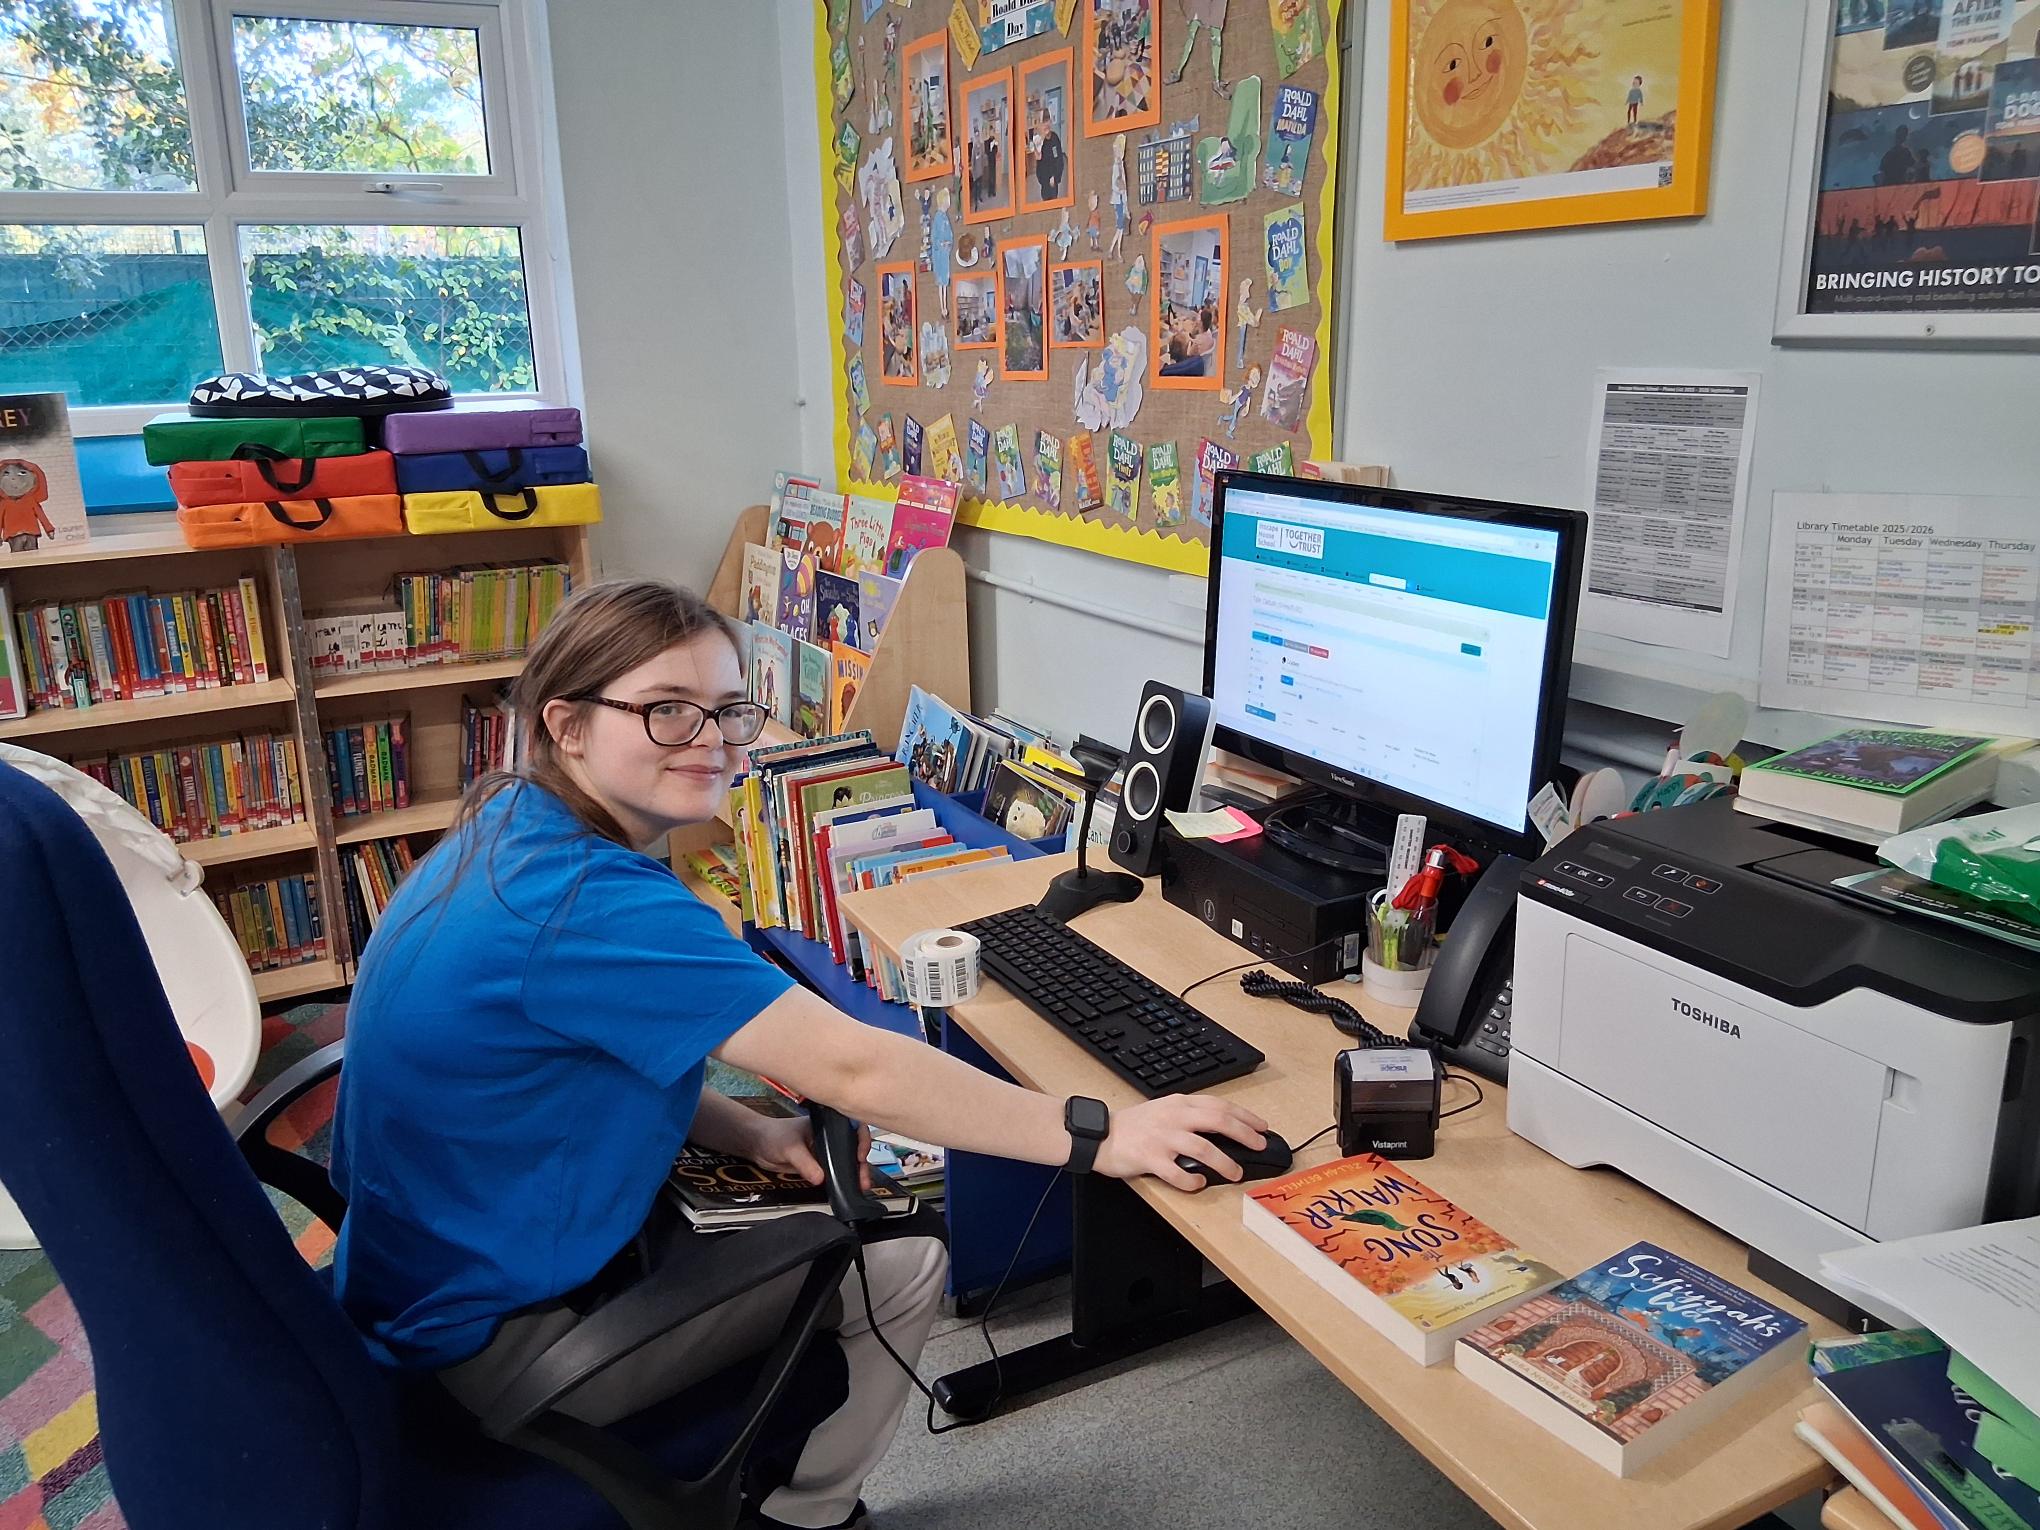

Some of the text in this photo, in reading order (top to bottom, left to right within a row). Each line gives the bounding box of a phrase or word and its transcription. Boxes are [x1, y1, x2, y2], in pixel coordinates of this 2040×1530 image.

[992, 1, 1016, 18] Roald
[1007, 22, 1024, 37] Day
[1283, 88, 1312, 107] ROALD
[1282, 103, 1308, 121] DAHL
[1276, 118, 1307, 135] MATILDA
[1272, 227, 1298, 245] ROALD
[1273, 242, 1299, 261] DAHL
[1816, 265, 2040, 290] BRINGING HISTORY TO
[1281, 328, 1309, 351] ROALD
[1281, 344, 1304, 364] DAHL
[1039, 441, 1059, 462] DAHL
[1113, 434, 1138, 456] ROALD
[1151, 444, 1172, 457] ROALD
[1205, 441, 1232, 464] ROALD
[1113, 447, 1134, 468] DAHL
[1152, 455, 1174, 470] DAHL
[1256, 447, 1284, 468] ROALD
[850, 515, 885, 540] Three Little
[1285, 528, 1322, 544] TOGETHER
[1797, 522, 1934, 534] Library Timetable 2025/2026
[860, 532, 873, 547] Pigs
[1298, 541, 1321, 554] TRUST
[1837, 535, 2035, 551] Monday Tuesday Wednesday Thursday
[167, 621, 180, 657] framed
[837, 660, 864, 681] MISSIN
[351, 753, 365, 777] FLEMBER
[367, 754, 379, 784] BADMAN
[379, 751, 391, 781] BADMAN
[1763, 763, 1902, 789] RICK RIORDAN
[1578, 869, 1590, 878] OK
[1672, 997, 1742, 1039] TOSHIBA
[1372, 1140, 1408, 1150] Vistaprint
[1277, 1161, 1363, 1192] ZILLAH BETHELL
[722, 1184, 776, 1192] GUIDE
[1292, 1175, 1423, 1230] WALKER
[1364, 1213, 1459, 1262] SONG
[1420, 1250, 1445, 1262] The
[1608, 1254, 1783, 1338] Safiyyah's
[1649, 1291, 1722, 1329] War
